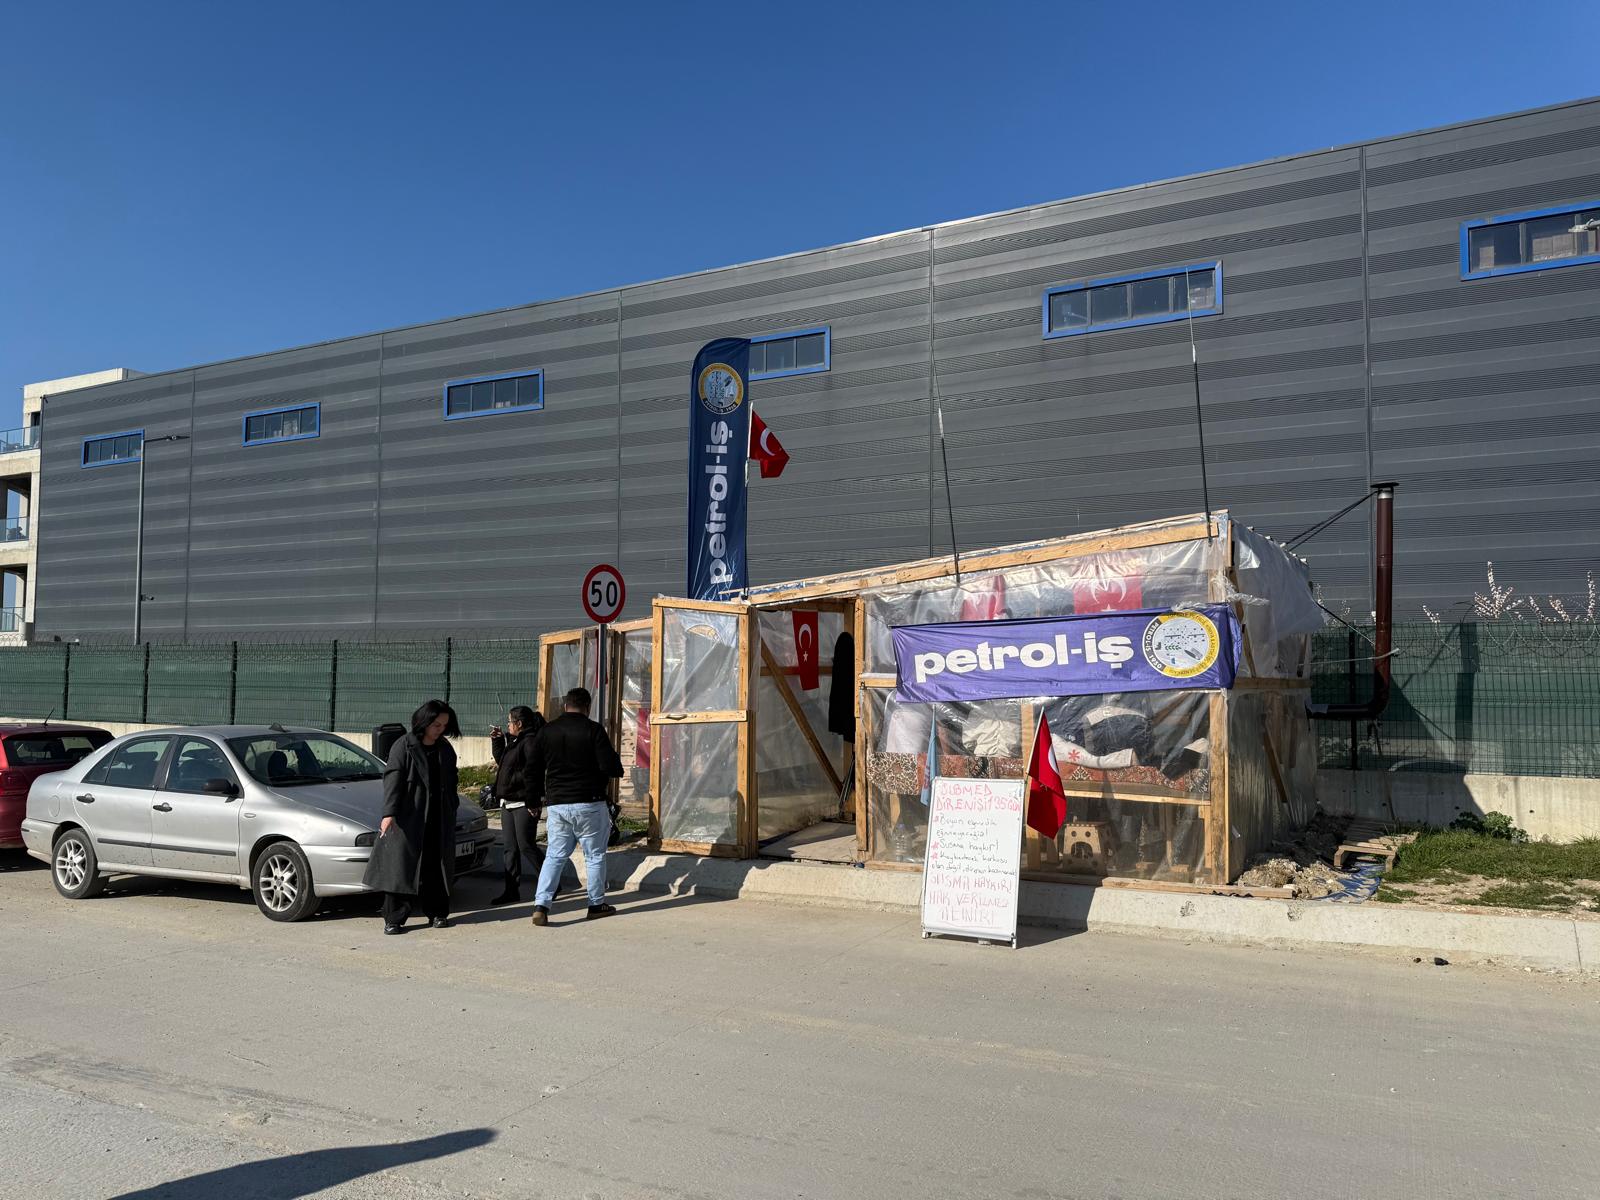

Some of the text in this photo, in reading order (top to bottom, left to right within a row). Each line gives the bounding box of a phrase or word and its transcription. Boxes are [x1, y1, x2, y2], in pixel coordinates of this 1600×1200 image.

[705, 420, 733, 584] petrol-iş
[591, 580, 618, 608] 50
[914, 632, 1134, 683] petrol-iş
